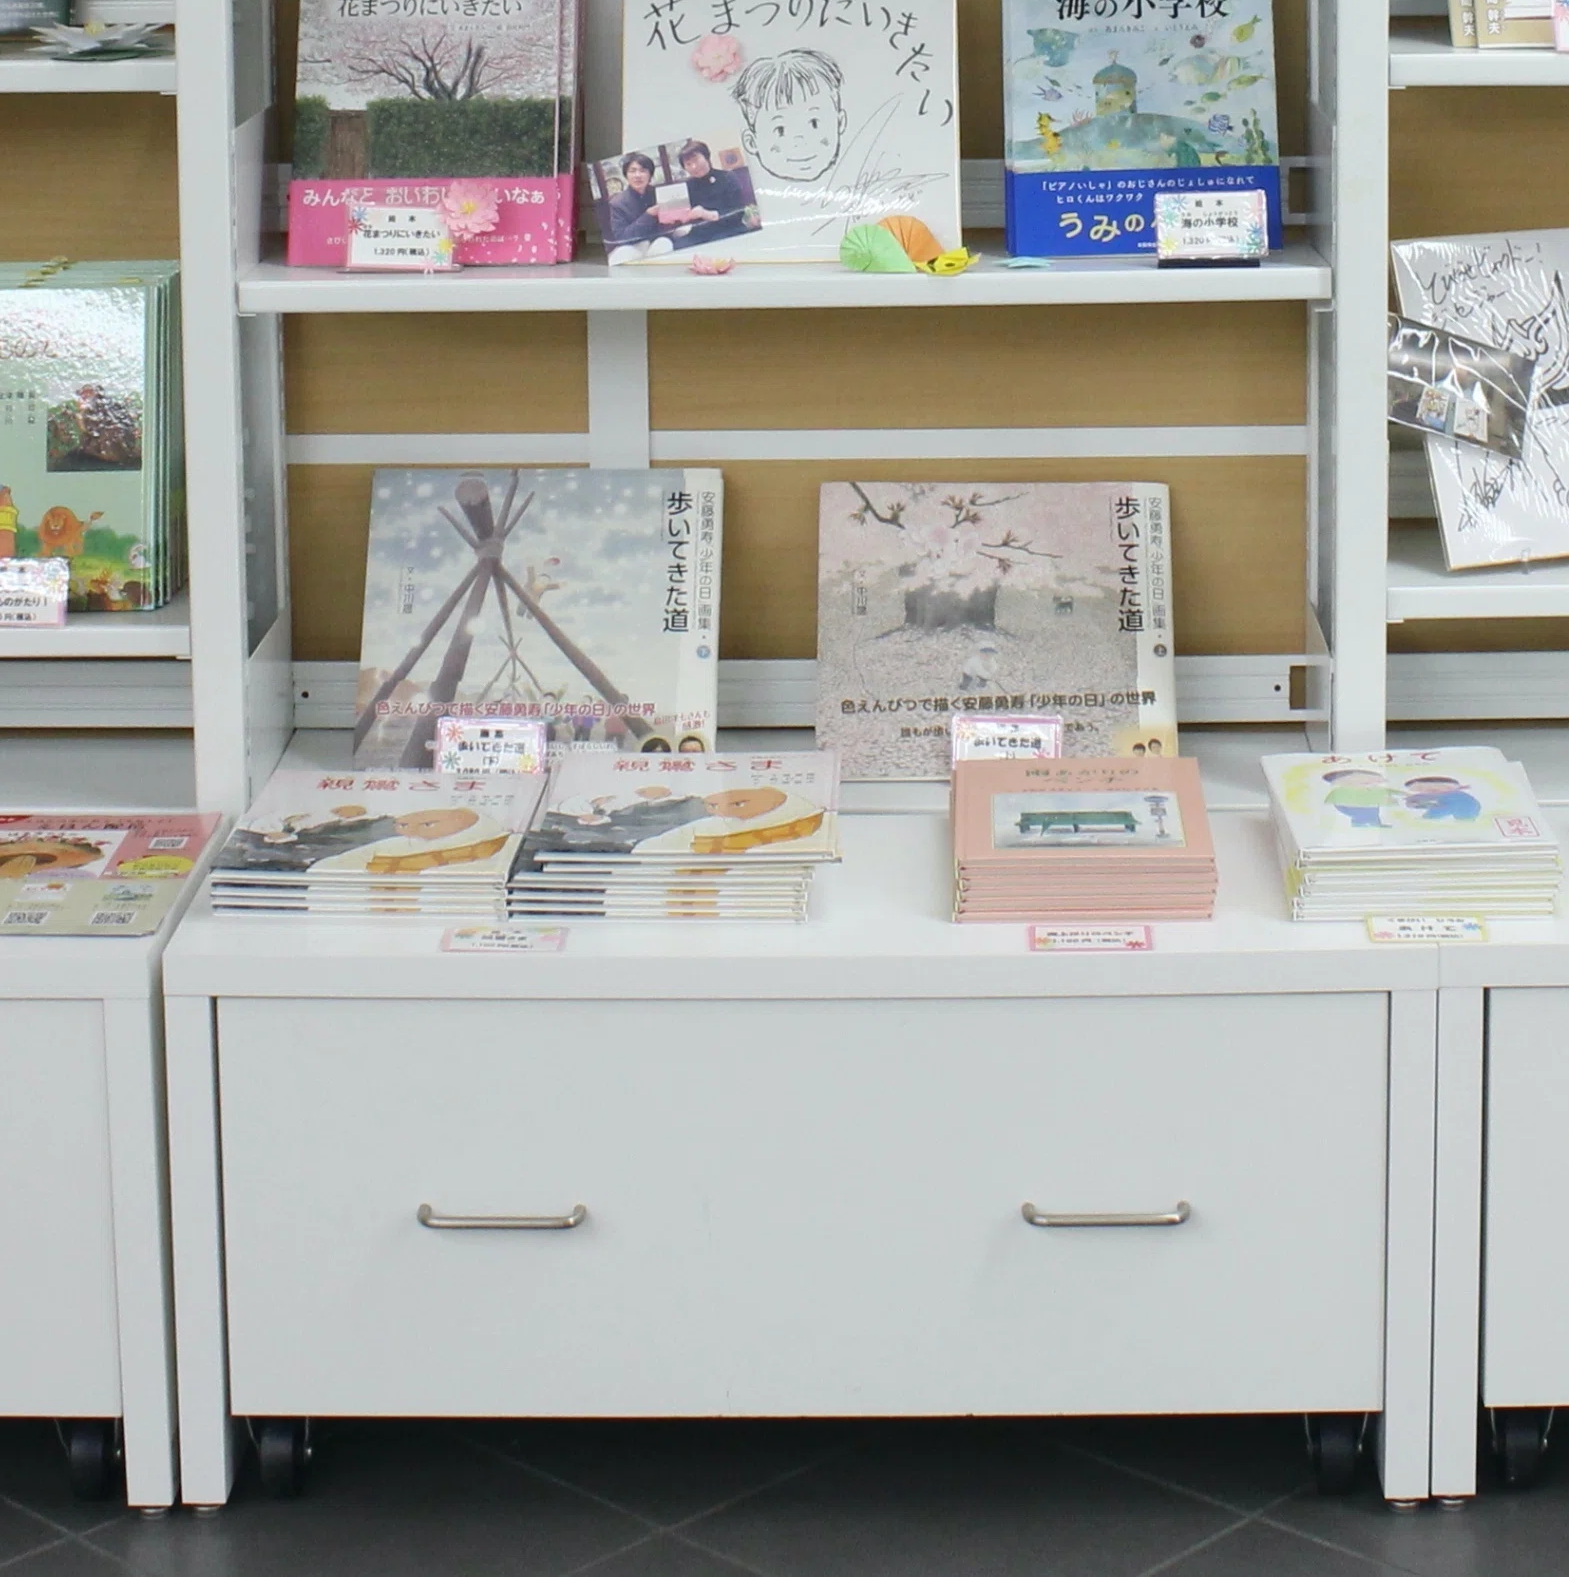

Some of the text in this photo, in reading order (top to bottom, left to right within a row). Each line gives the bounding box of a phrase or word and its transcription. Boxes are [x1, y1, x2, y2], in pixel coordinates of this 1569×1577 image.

[362, 228, 441, 239] 花まつりにいきたい
[1181, 217, 1239, 229] 海の小学校
[662, 490, 694, 634] 歩いてきた道
[697, 546, 714, 600] 少年の日
[1113, 496, 1146, 633] 歩いてきた道
[1149, 551, 1165, 601] 少年の日
[376, 701, 656, 718] 色えんぴつで描く安藤勇寿「少年の日」の世界
[840, 690, 1157, 715] 色えんぴつで描く安藤勇寿「少年の日」の世界
